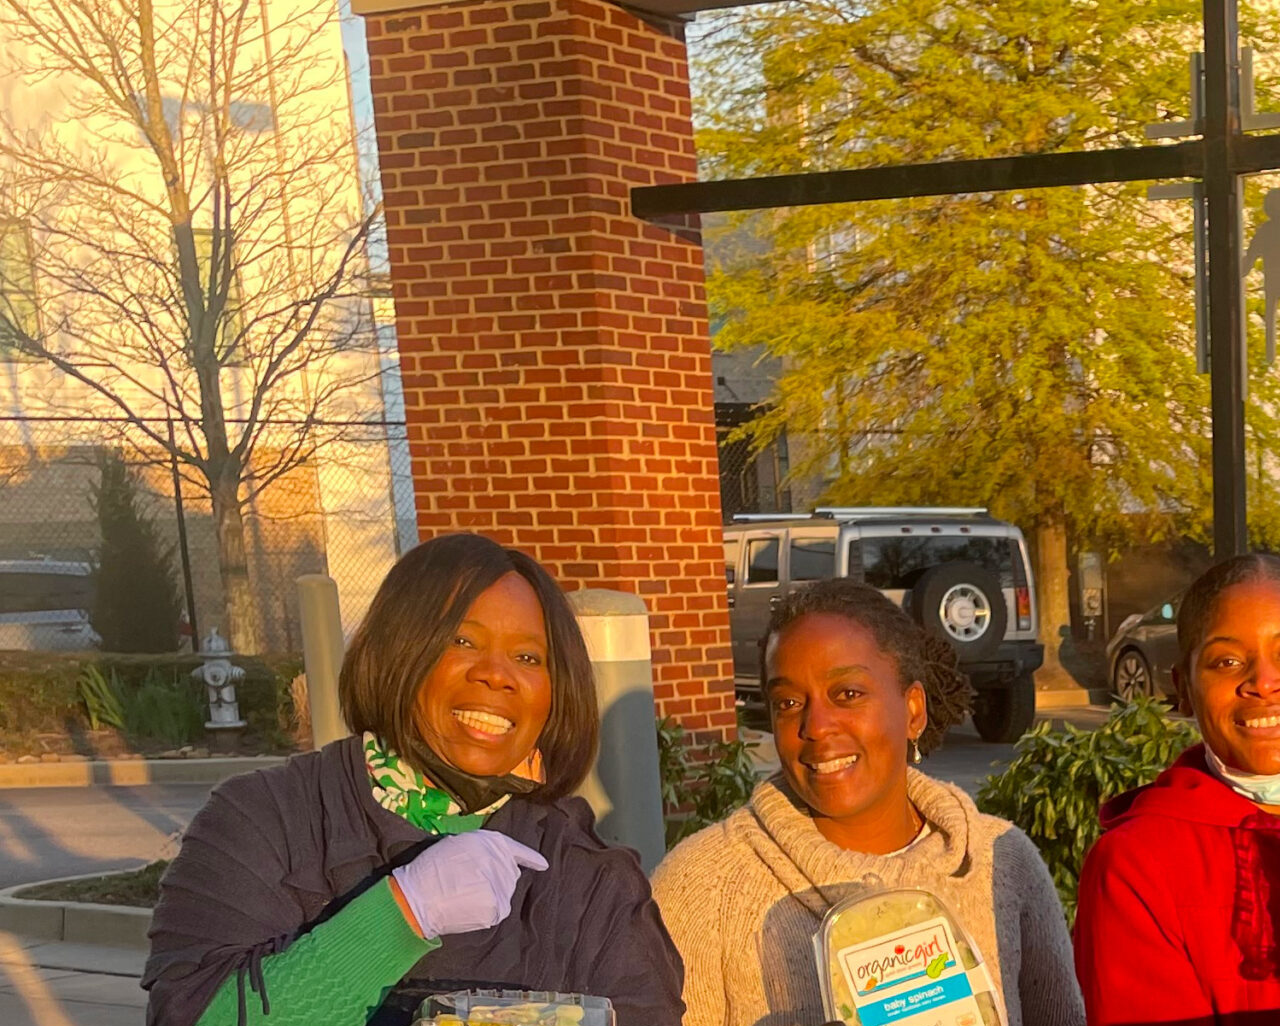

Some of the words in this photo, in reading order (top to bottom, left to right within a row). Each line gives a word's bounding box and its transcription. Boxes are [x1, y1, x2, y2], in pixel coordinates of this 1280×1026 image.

[857, 934, 943, 982] organicgirl
[883, 998, 906, 1012] baby
[908, 986, 944, 1003] spinach
